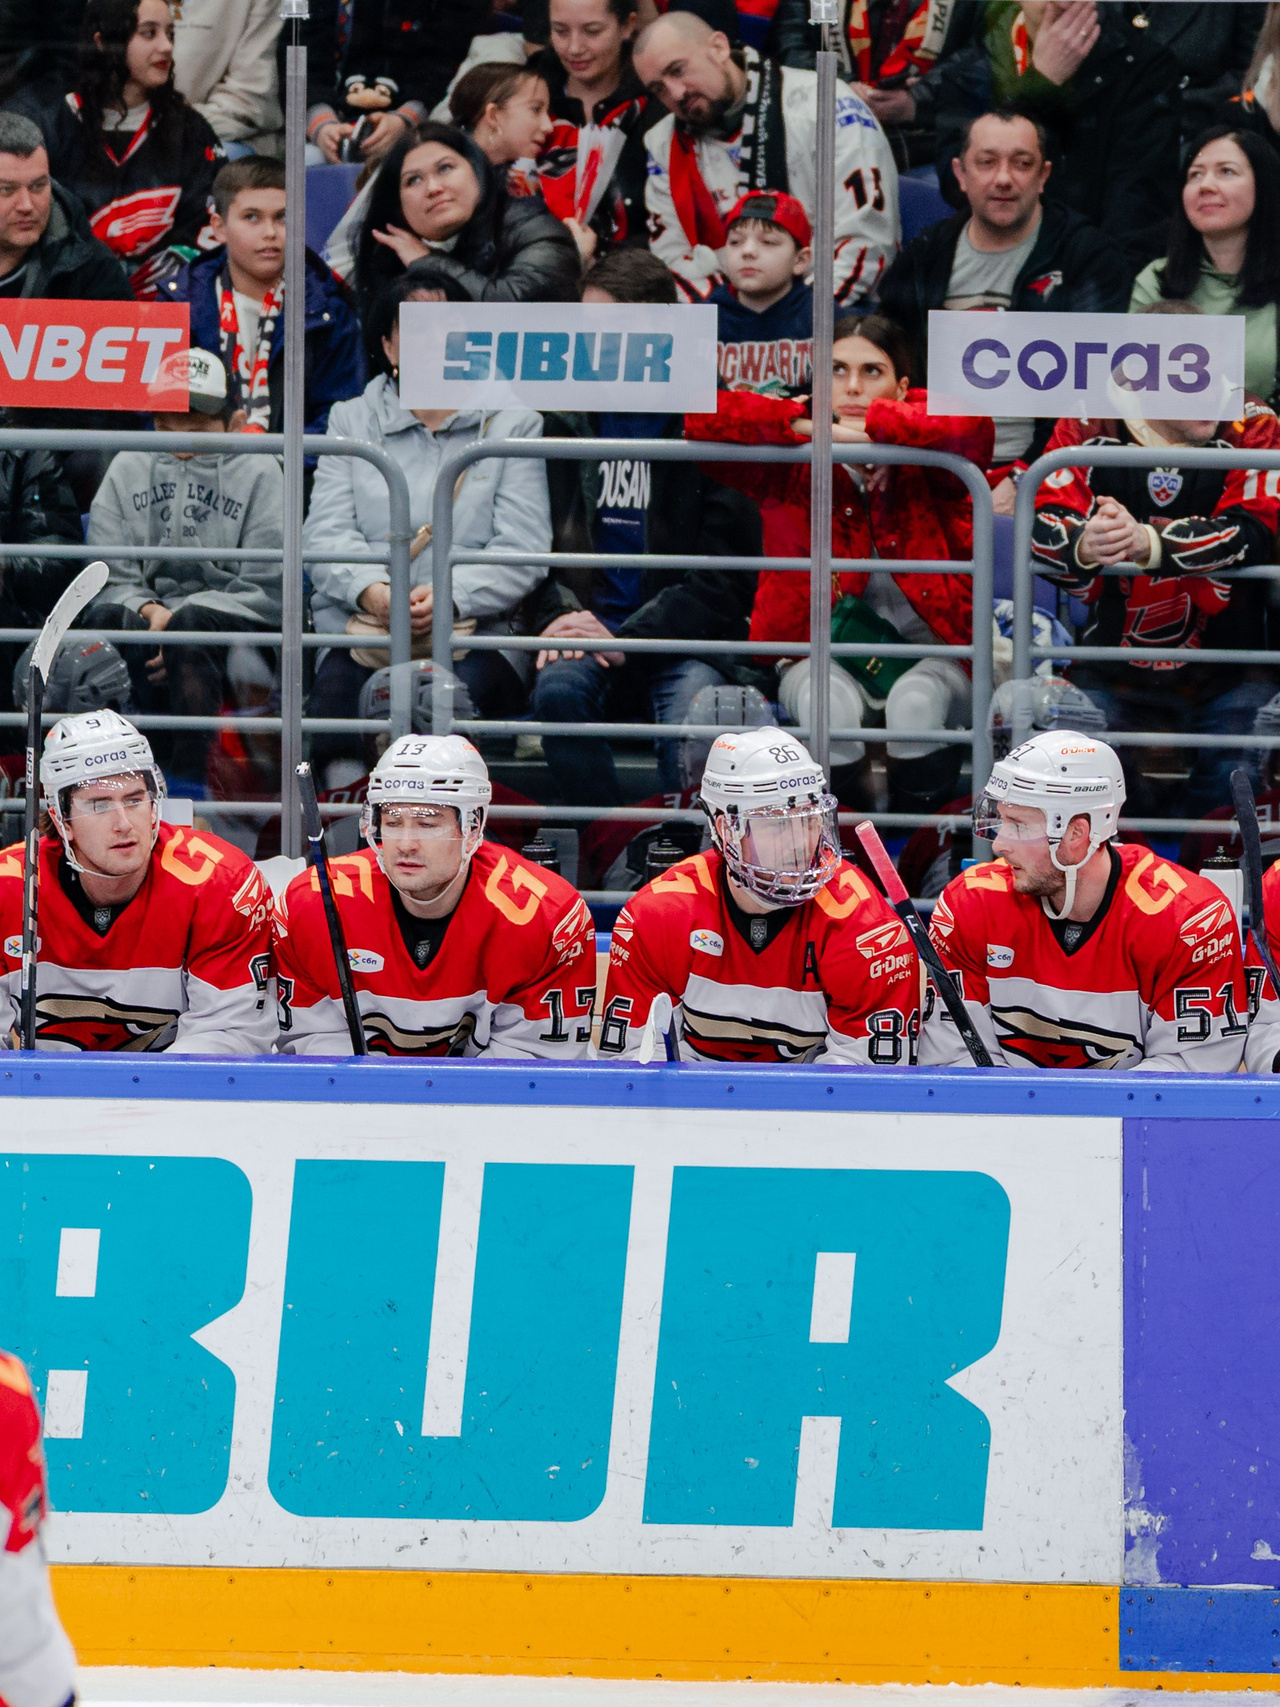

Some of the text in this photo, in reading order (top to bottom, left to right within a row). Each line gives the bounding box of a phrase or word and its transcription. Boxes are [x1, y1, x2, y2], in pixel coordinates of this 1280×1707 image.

[443, 331, 673, 383] SIBUR
[86, 719, 101, 729] 9
[396, 743, 428, 755] 13
[768, 745, 800, 764] 86
[802, 941, 820, 986] A
[1174, 982, 1248, 1042] 51
